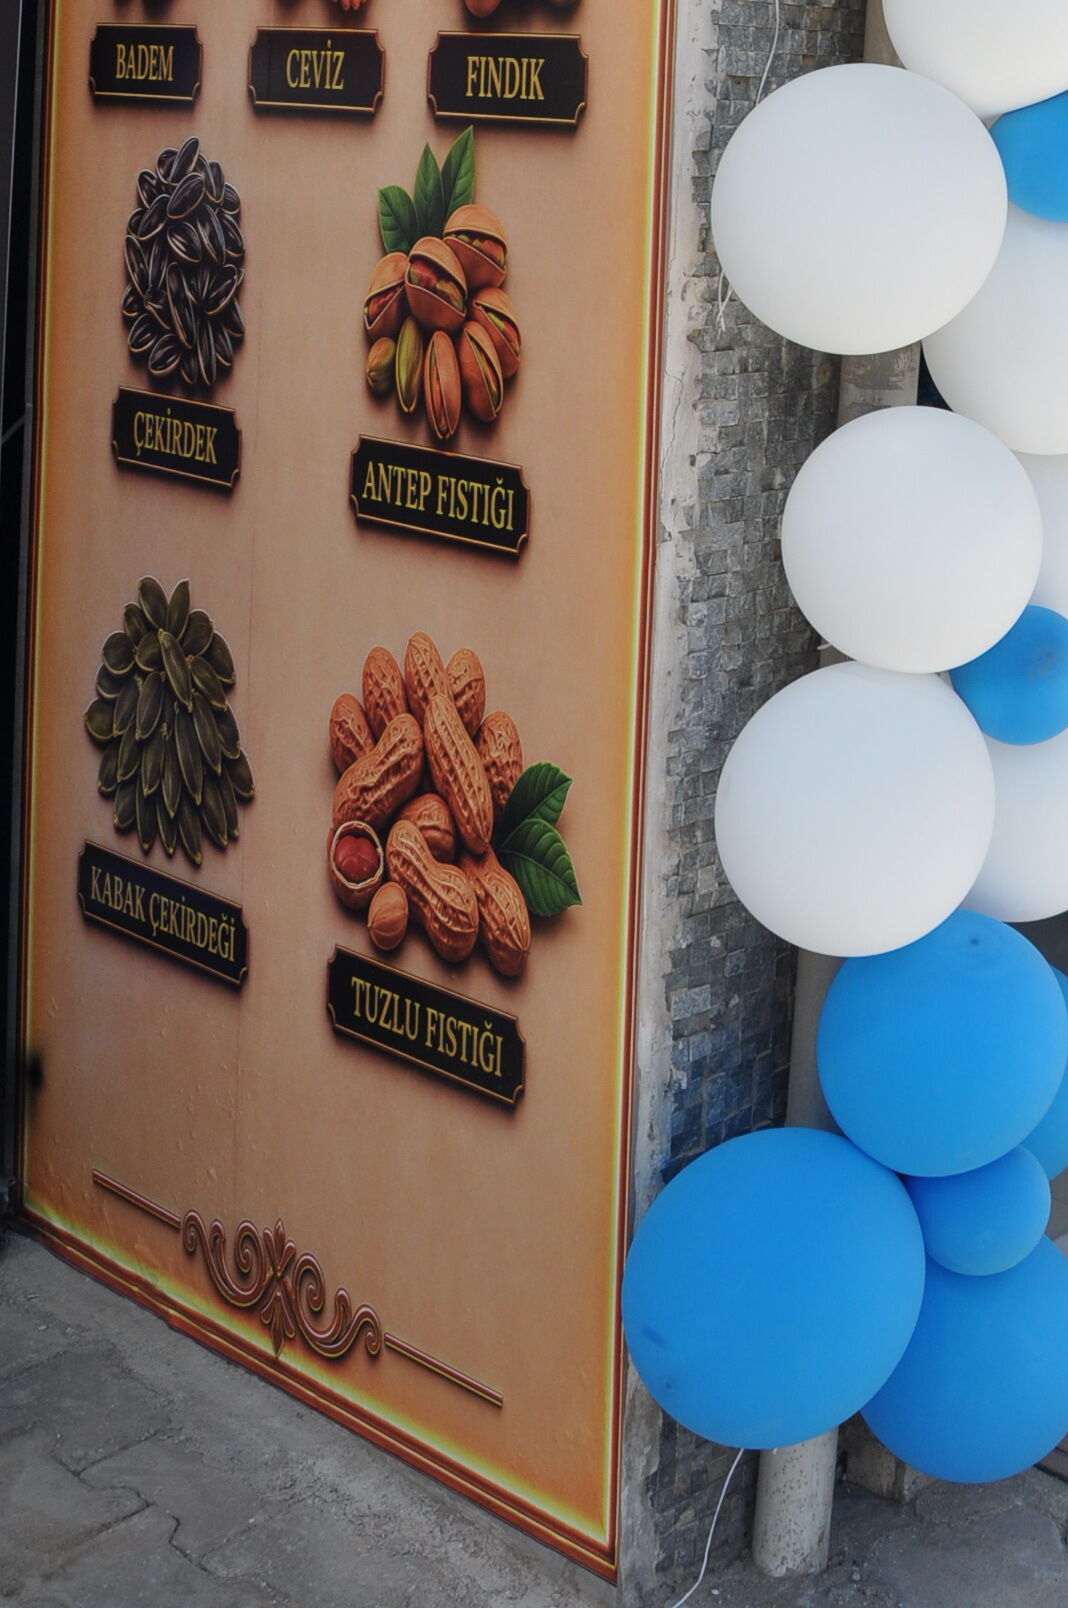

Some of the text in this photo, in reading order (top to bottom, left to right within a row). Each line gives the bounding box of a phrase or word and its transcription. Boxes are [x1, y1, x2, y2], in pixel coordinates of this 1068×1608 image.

[115, 44, 174, 81] BADEM
[286, 39, 345, 90] CEVİZ
[465, 55, 545, 100] FINDIK
[133, 407, 218, 465] ÇEKİRDEK
[361, 460, 515, 531] ANTEP FISTIĞI
[90, 865, 236, 963] KABAK ÇEKİRDEĞİ
[351, 976, 503, 1078] TUZLU FISTIĞI
